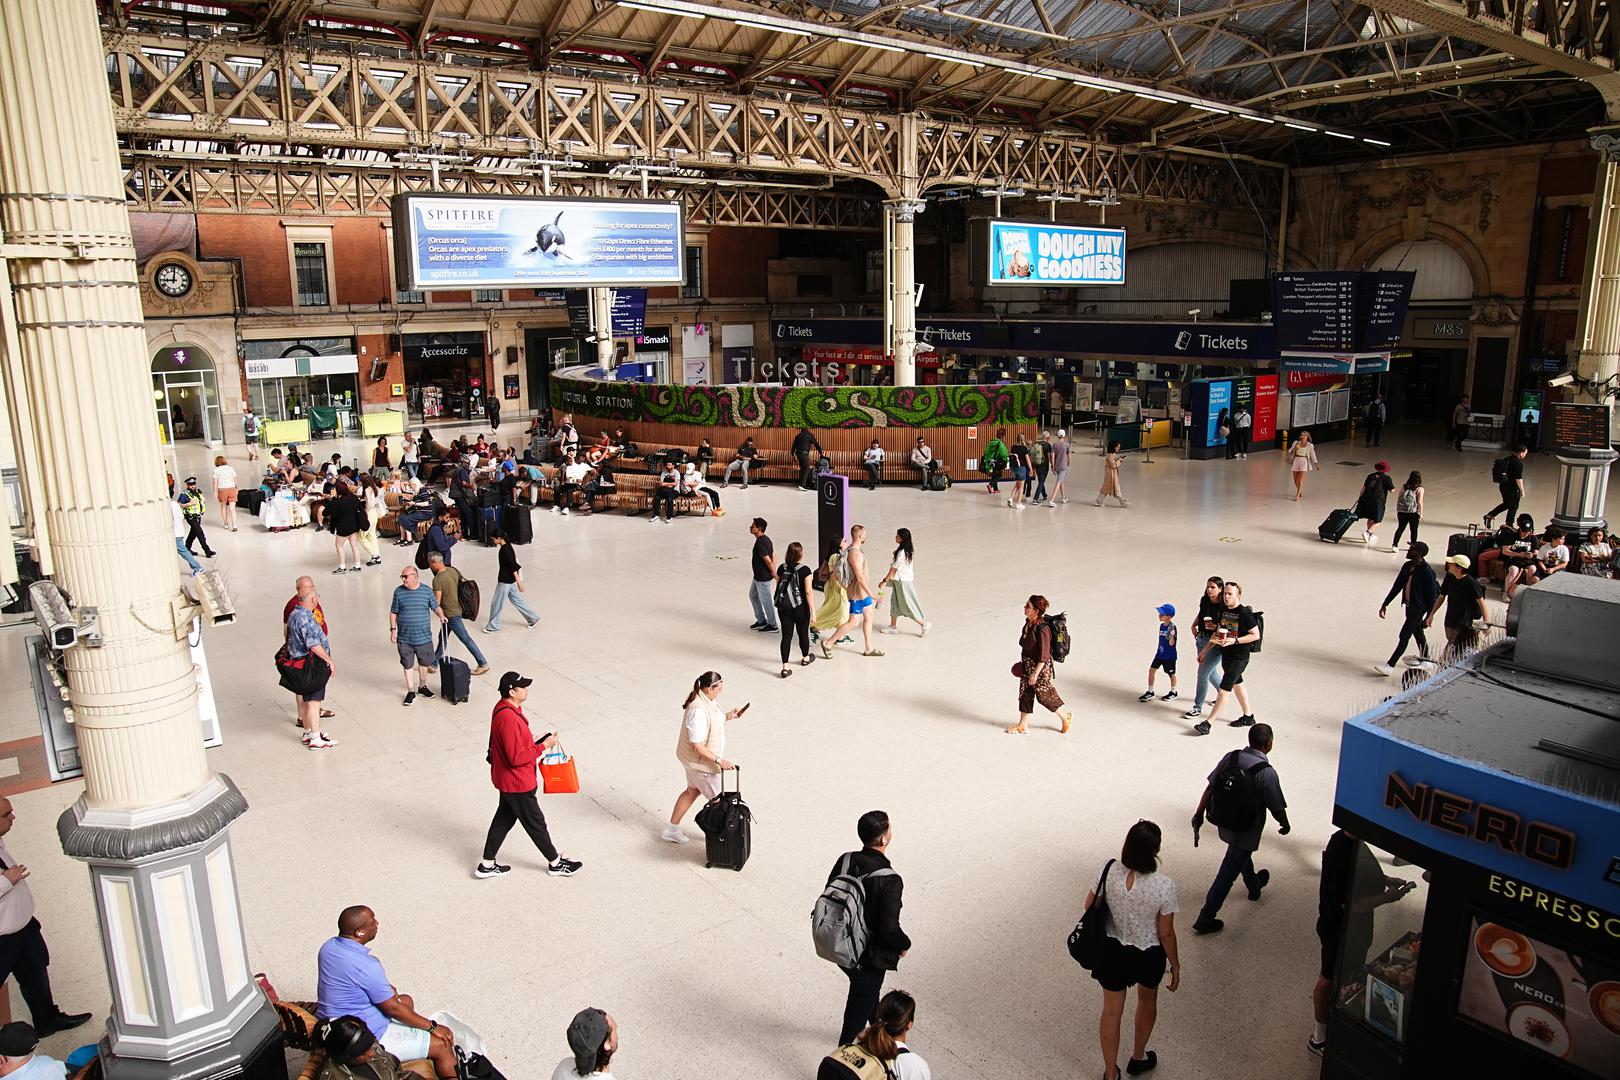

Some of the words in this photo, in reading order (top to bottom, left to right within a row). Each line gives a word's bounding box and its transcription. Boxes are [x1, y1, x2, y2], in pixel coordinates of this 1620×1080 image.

[428, 209, 495, 221] SPITFIRE
[478, 245, 508, 254] predators
[1038, 232, 1096, 259] DOUGH
[1096, 235, 1124, 256] MY
[1038, 254, 1122, 279] GOODNESS
[430, 270, 480, 279] spitfire.co.uk
[788, 326, 813, 337] Tickets
[939, 328, 971, 341] Tickets
[1435, 323, 1464, 335] M&S
[643, 336, 669, 344] iSmash
[1199, 334, 1248, 351] Tickets
[420, 345, 468, 358] Accessorize
[248, 363, 268, 372] wasabi
[732, 357, 840, 378] Tickets
[596, 396, 633, 409] STATION
[1383, 771, 1577, 870] NERO
[1513, 982, 1554, 1004] NERO
